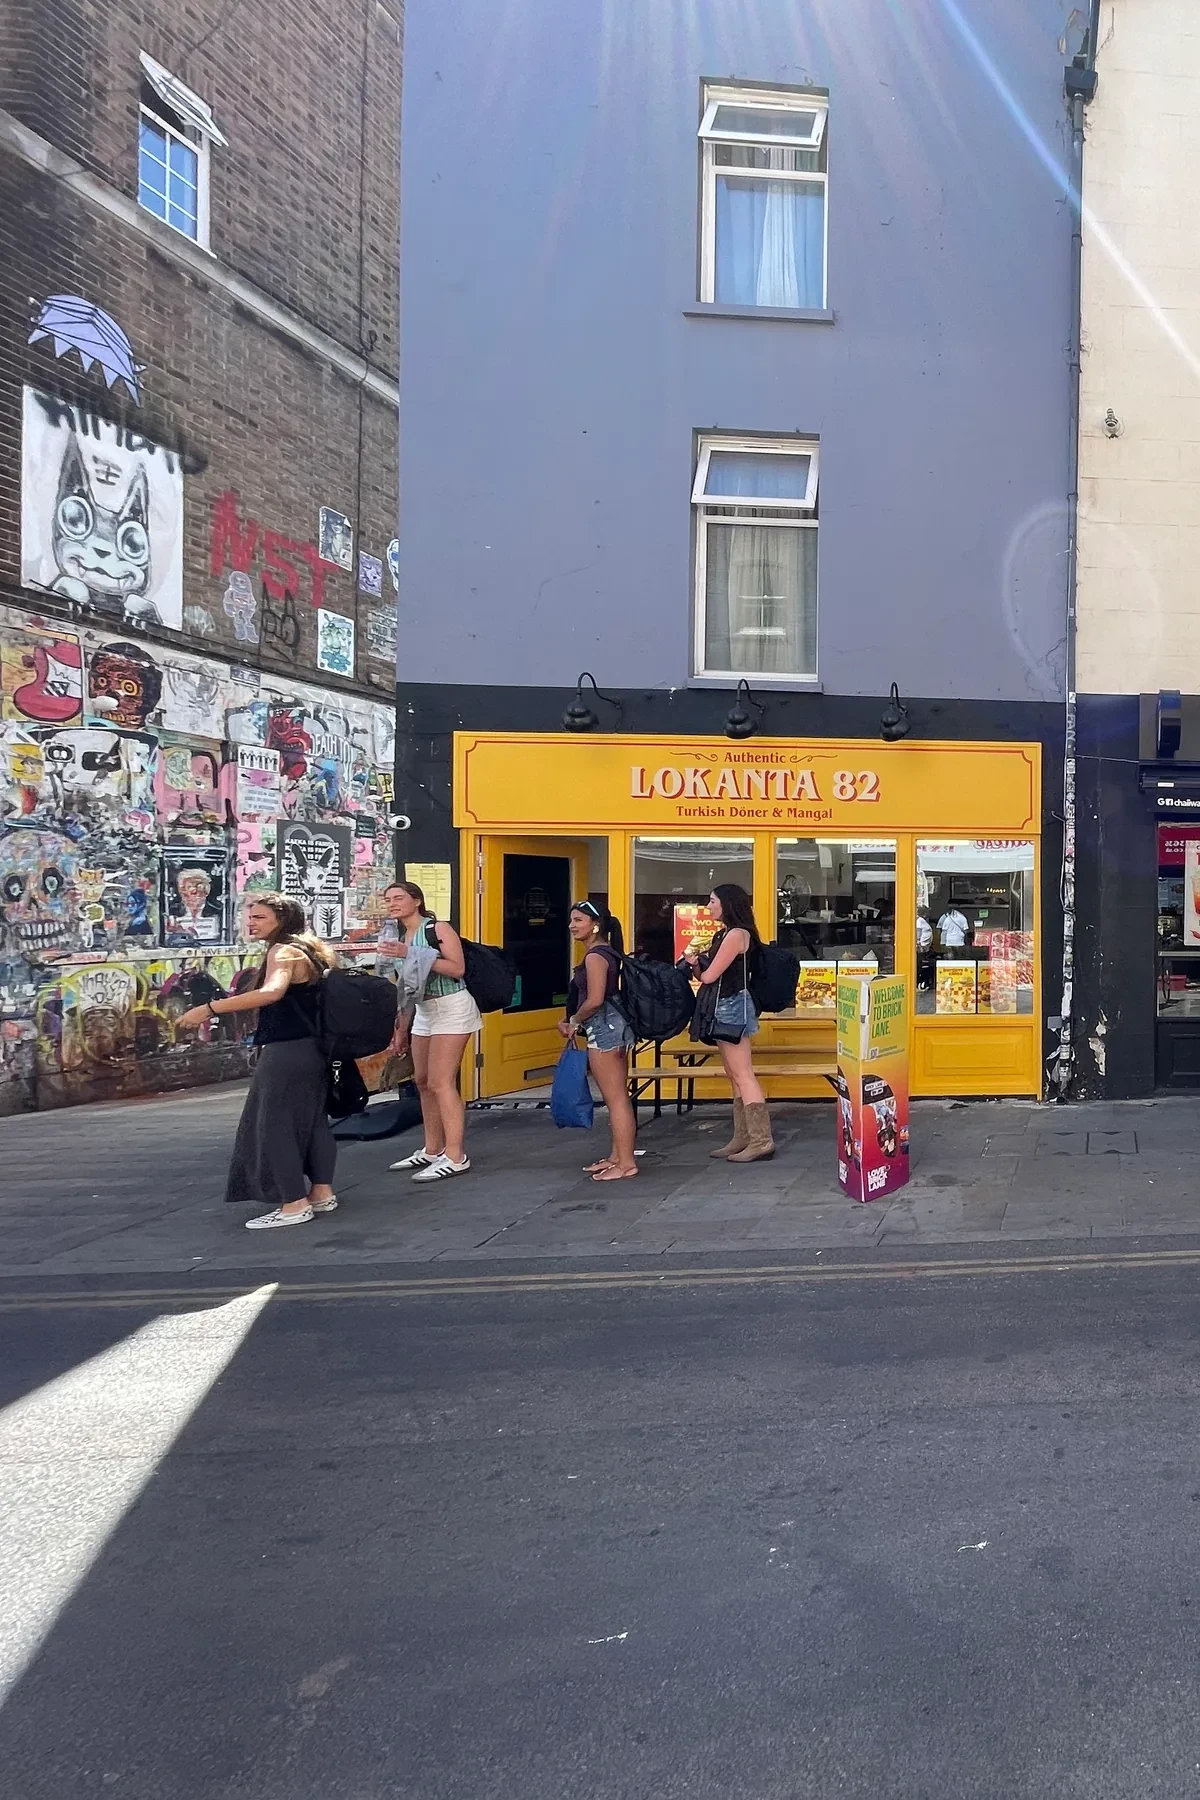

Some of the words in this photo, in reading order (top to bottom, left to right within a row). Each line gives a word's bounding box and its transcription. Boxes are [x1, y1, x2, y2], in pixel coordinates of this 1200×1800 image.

[724, 752, 787, 764] Authentic
[630, 766, 823, 801] LOKANTA
[832, 770, 882, 802] 82
[676, 805, 725, 817] Turkish
[729, 805, 768, 818] Döner
[772, 807, 783, 818] &
[787, 806, 833, 821] Mangal
[692, 918, 712, 926] two
[874, 984, 905, 1005] WELCOME
[873, 1005, 881, 1021] TO
[883, 1001, 902, 1019] BRICK
